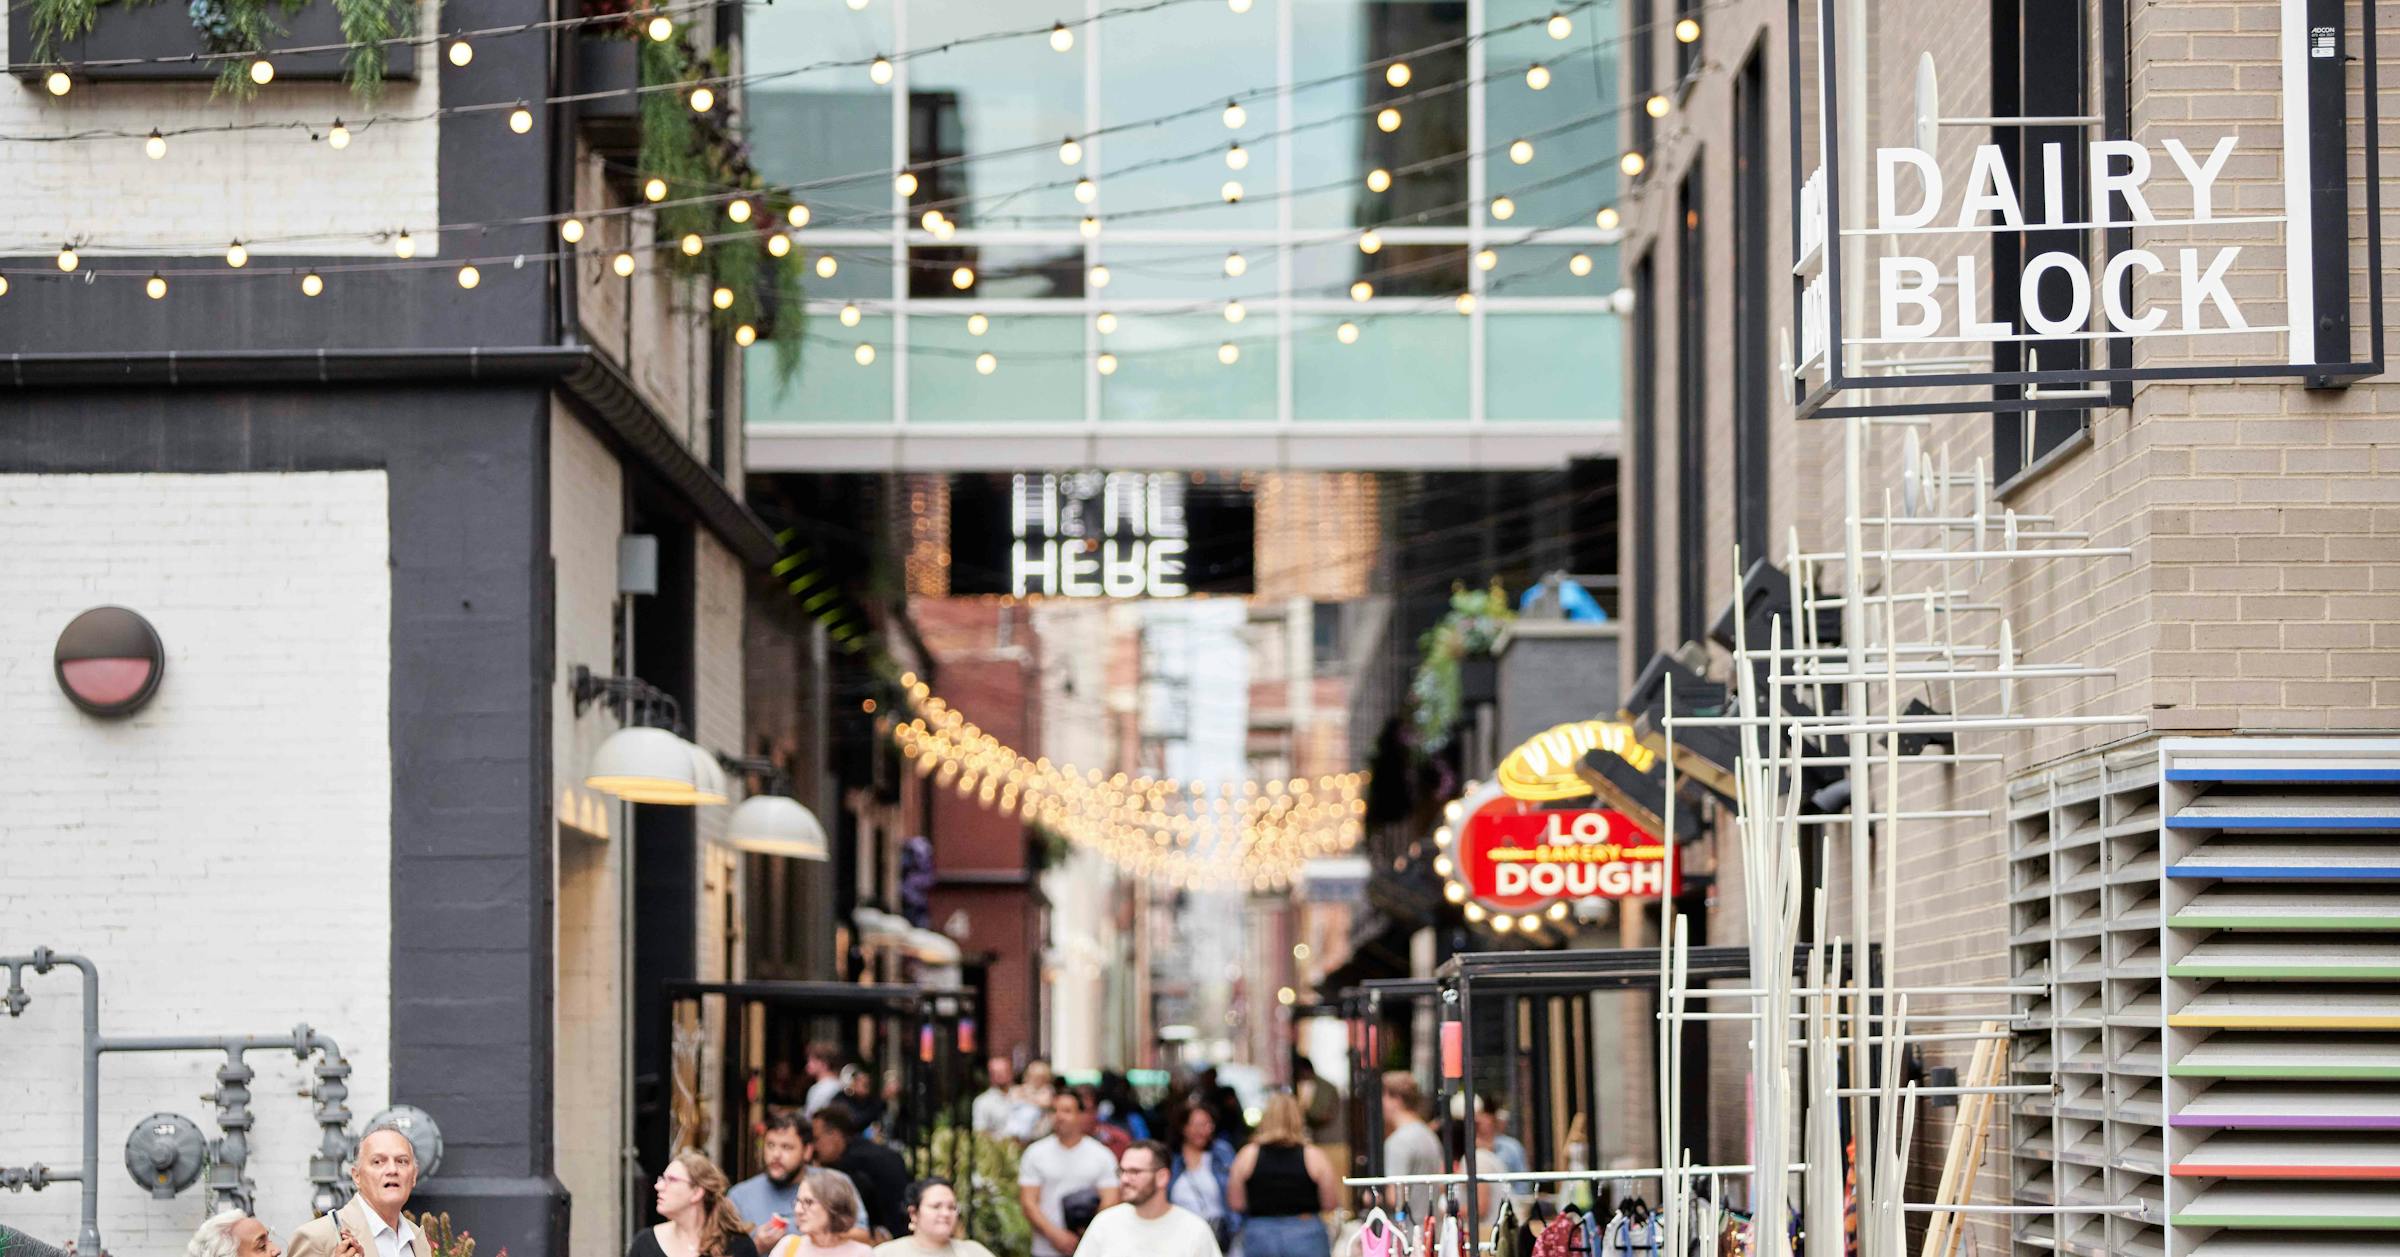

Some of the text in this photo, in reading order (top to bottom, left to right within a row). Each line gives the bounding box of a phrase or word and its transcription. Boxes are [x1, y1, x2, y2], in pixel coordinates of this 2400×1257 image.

[1876, 136, 2239, 229] DAIRY
[1879, 246, 2249, 339] BLOCK
[1547, 813, 1610, 846] LO
[1535, 844, 1622, 863] BAKERY
[1495, 862, 1662, 897] DOUGH
